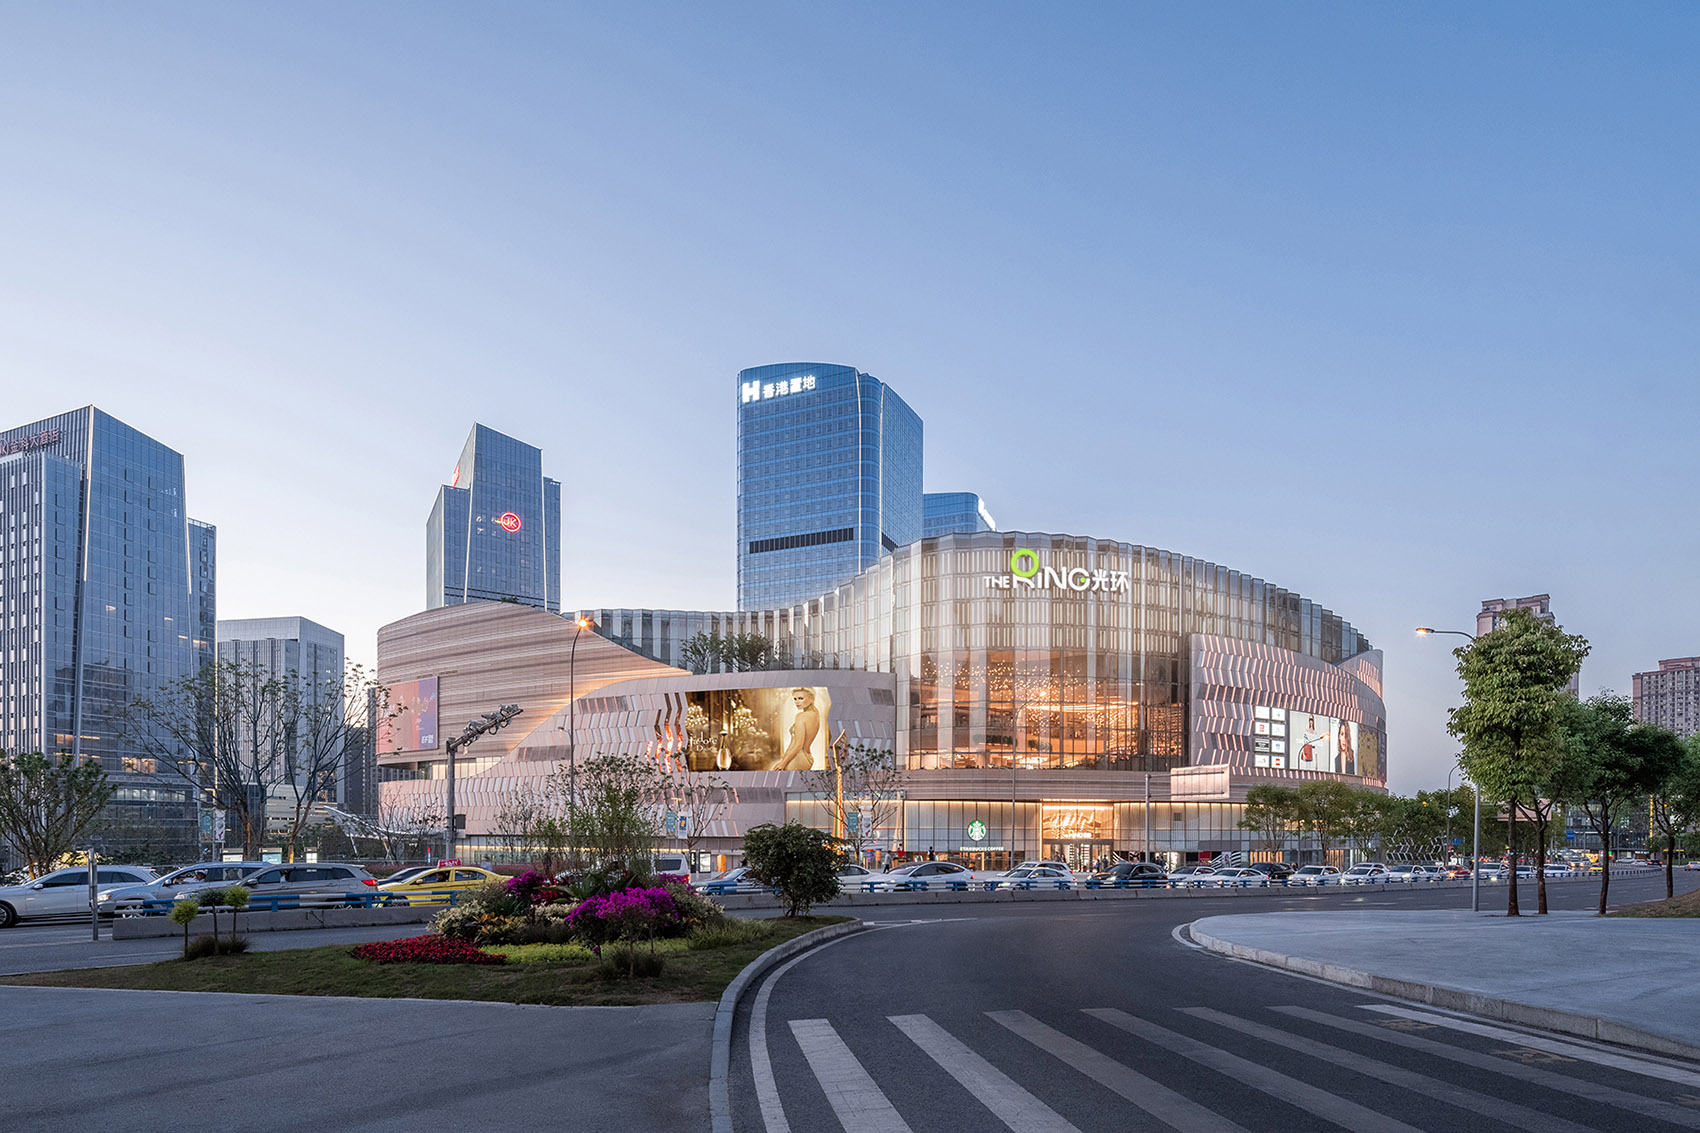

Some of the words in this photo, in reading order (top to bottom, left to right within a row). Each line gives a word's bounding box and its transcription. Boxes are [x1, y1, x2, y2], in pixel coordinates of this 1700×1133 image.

[763, 375, 816, 399] 香港置地
[984, 576, 1010, 588] THE
[1092, 568, 1129, 593] 光环
